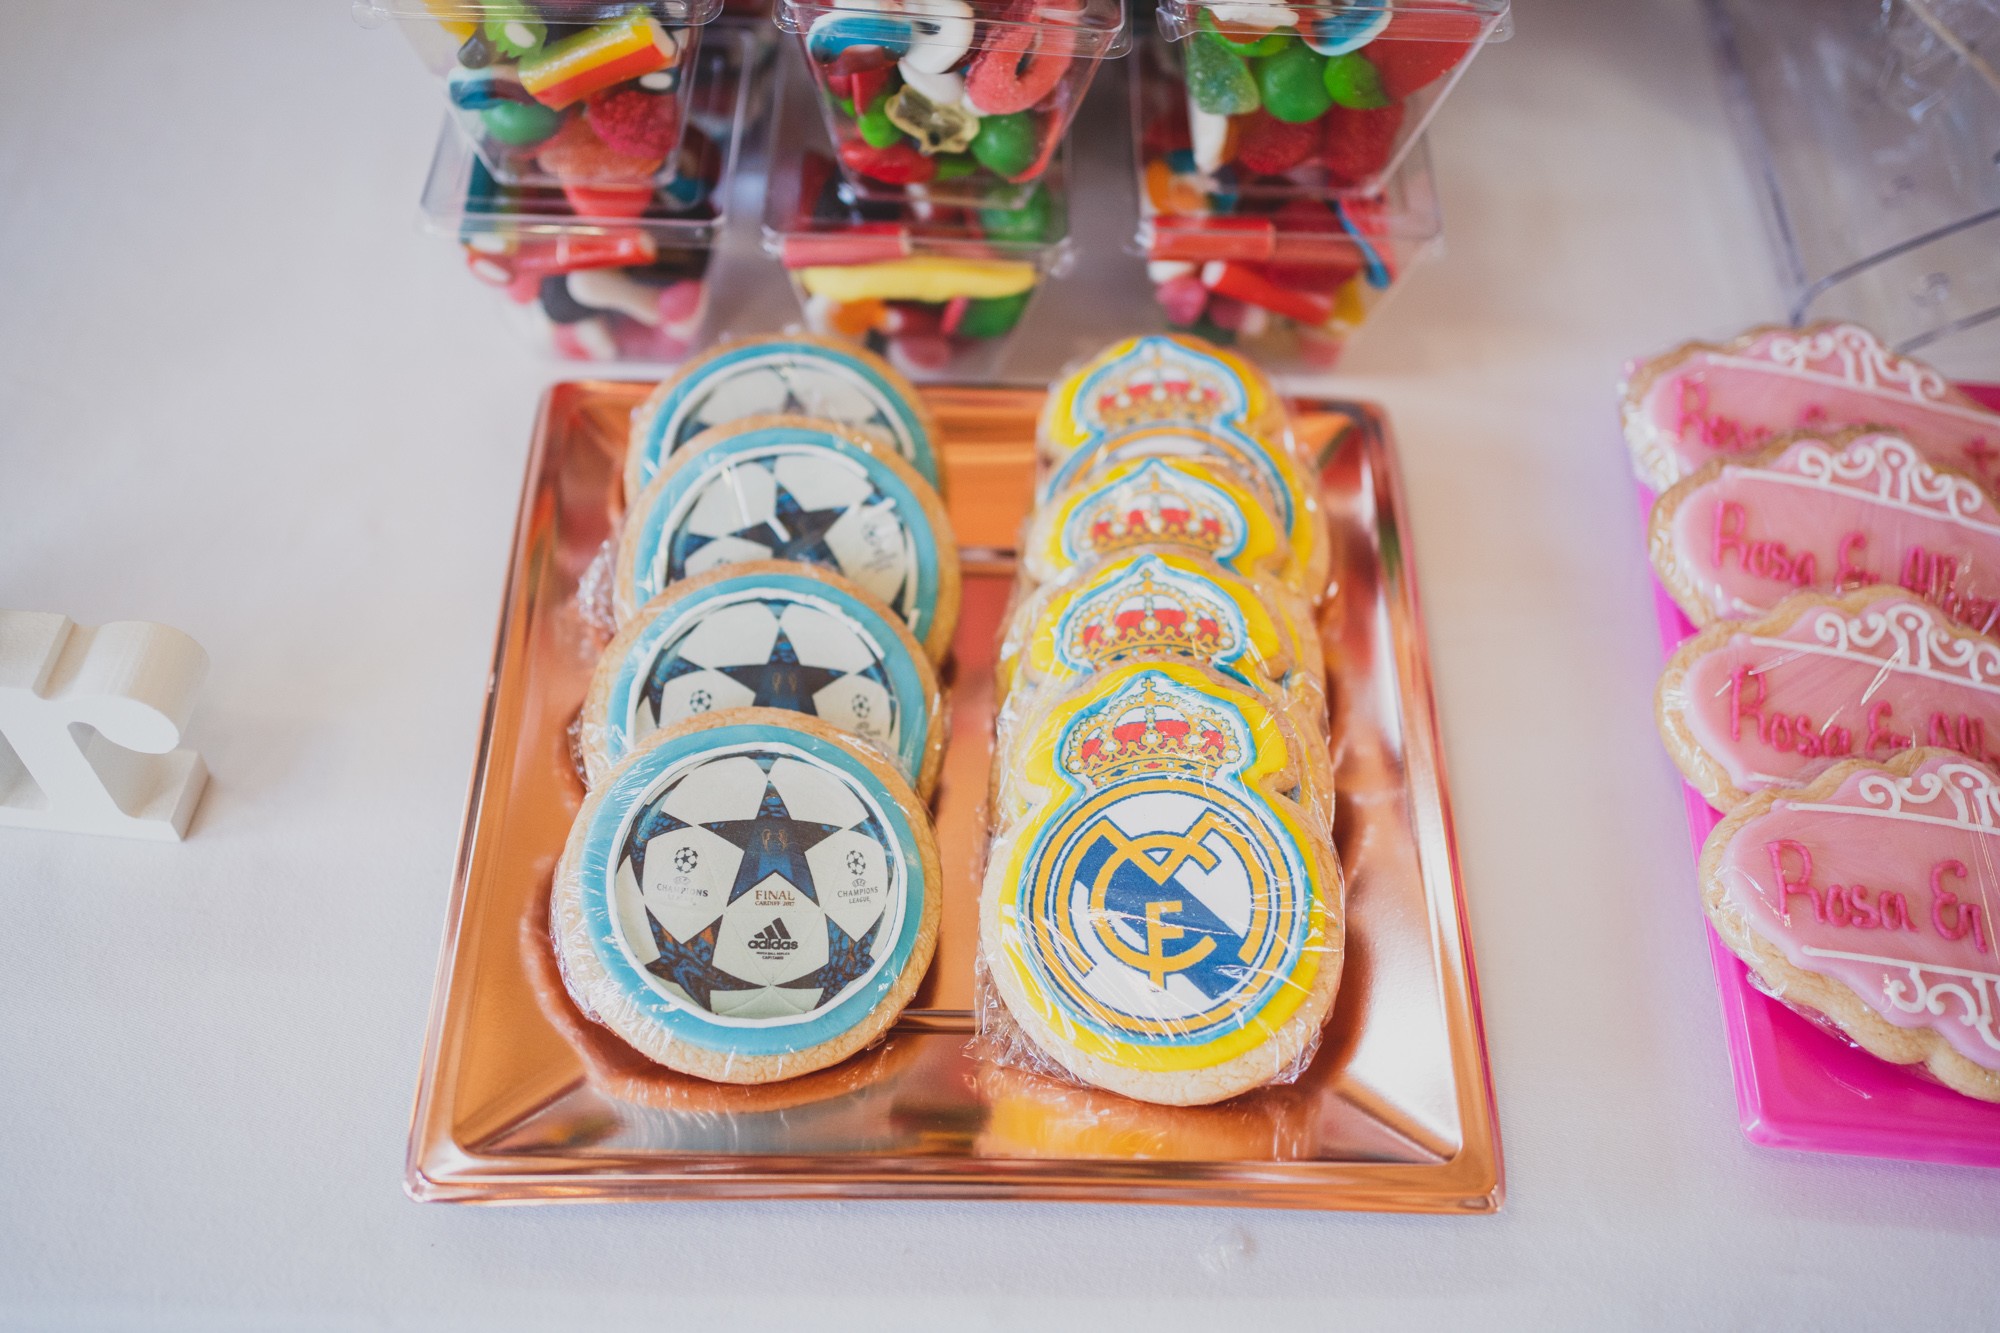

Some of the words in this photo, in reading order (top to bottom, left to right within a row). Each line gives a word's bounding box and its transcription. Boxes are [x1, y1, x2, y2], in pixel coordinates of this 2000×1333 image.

[1731, 664, 1851, 758] Rosa
[837, 886, 879, 898] CHAMPIONS
[1765, 839, 1920, 934] Rosa
[755, 890, 796, 901] FINAL
[747, 938, 799, 950] adidas
